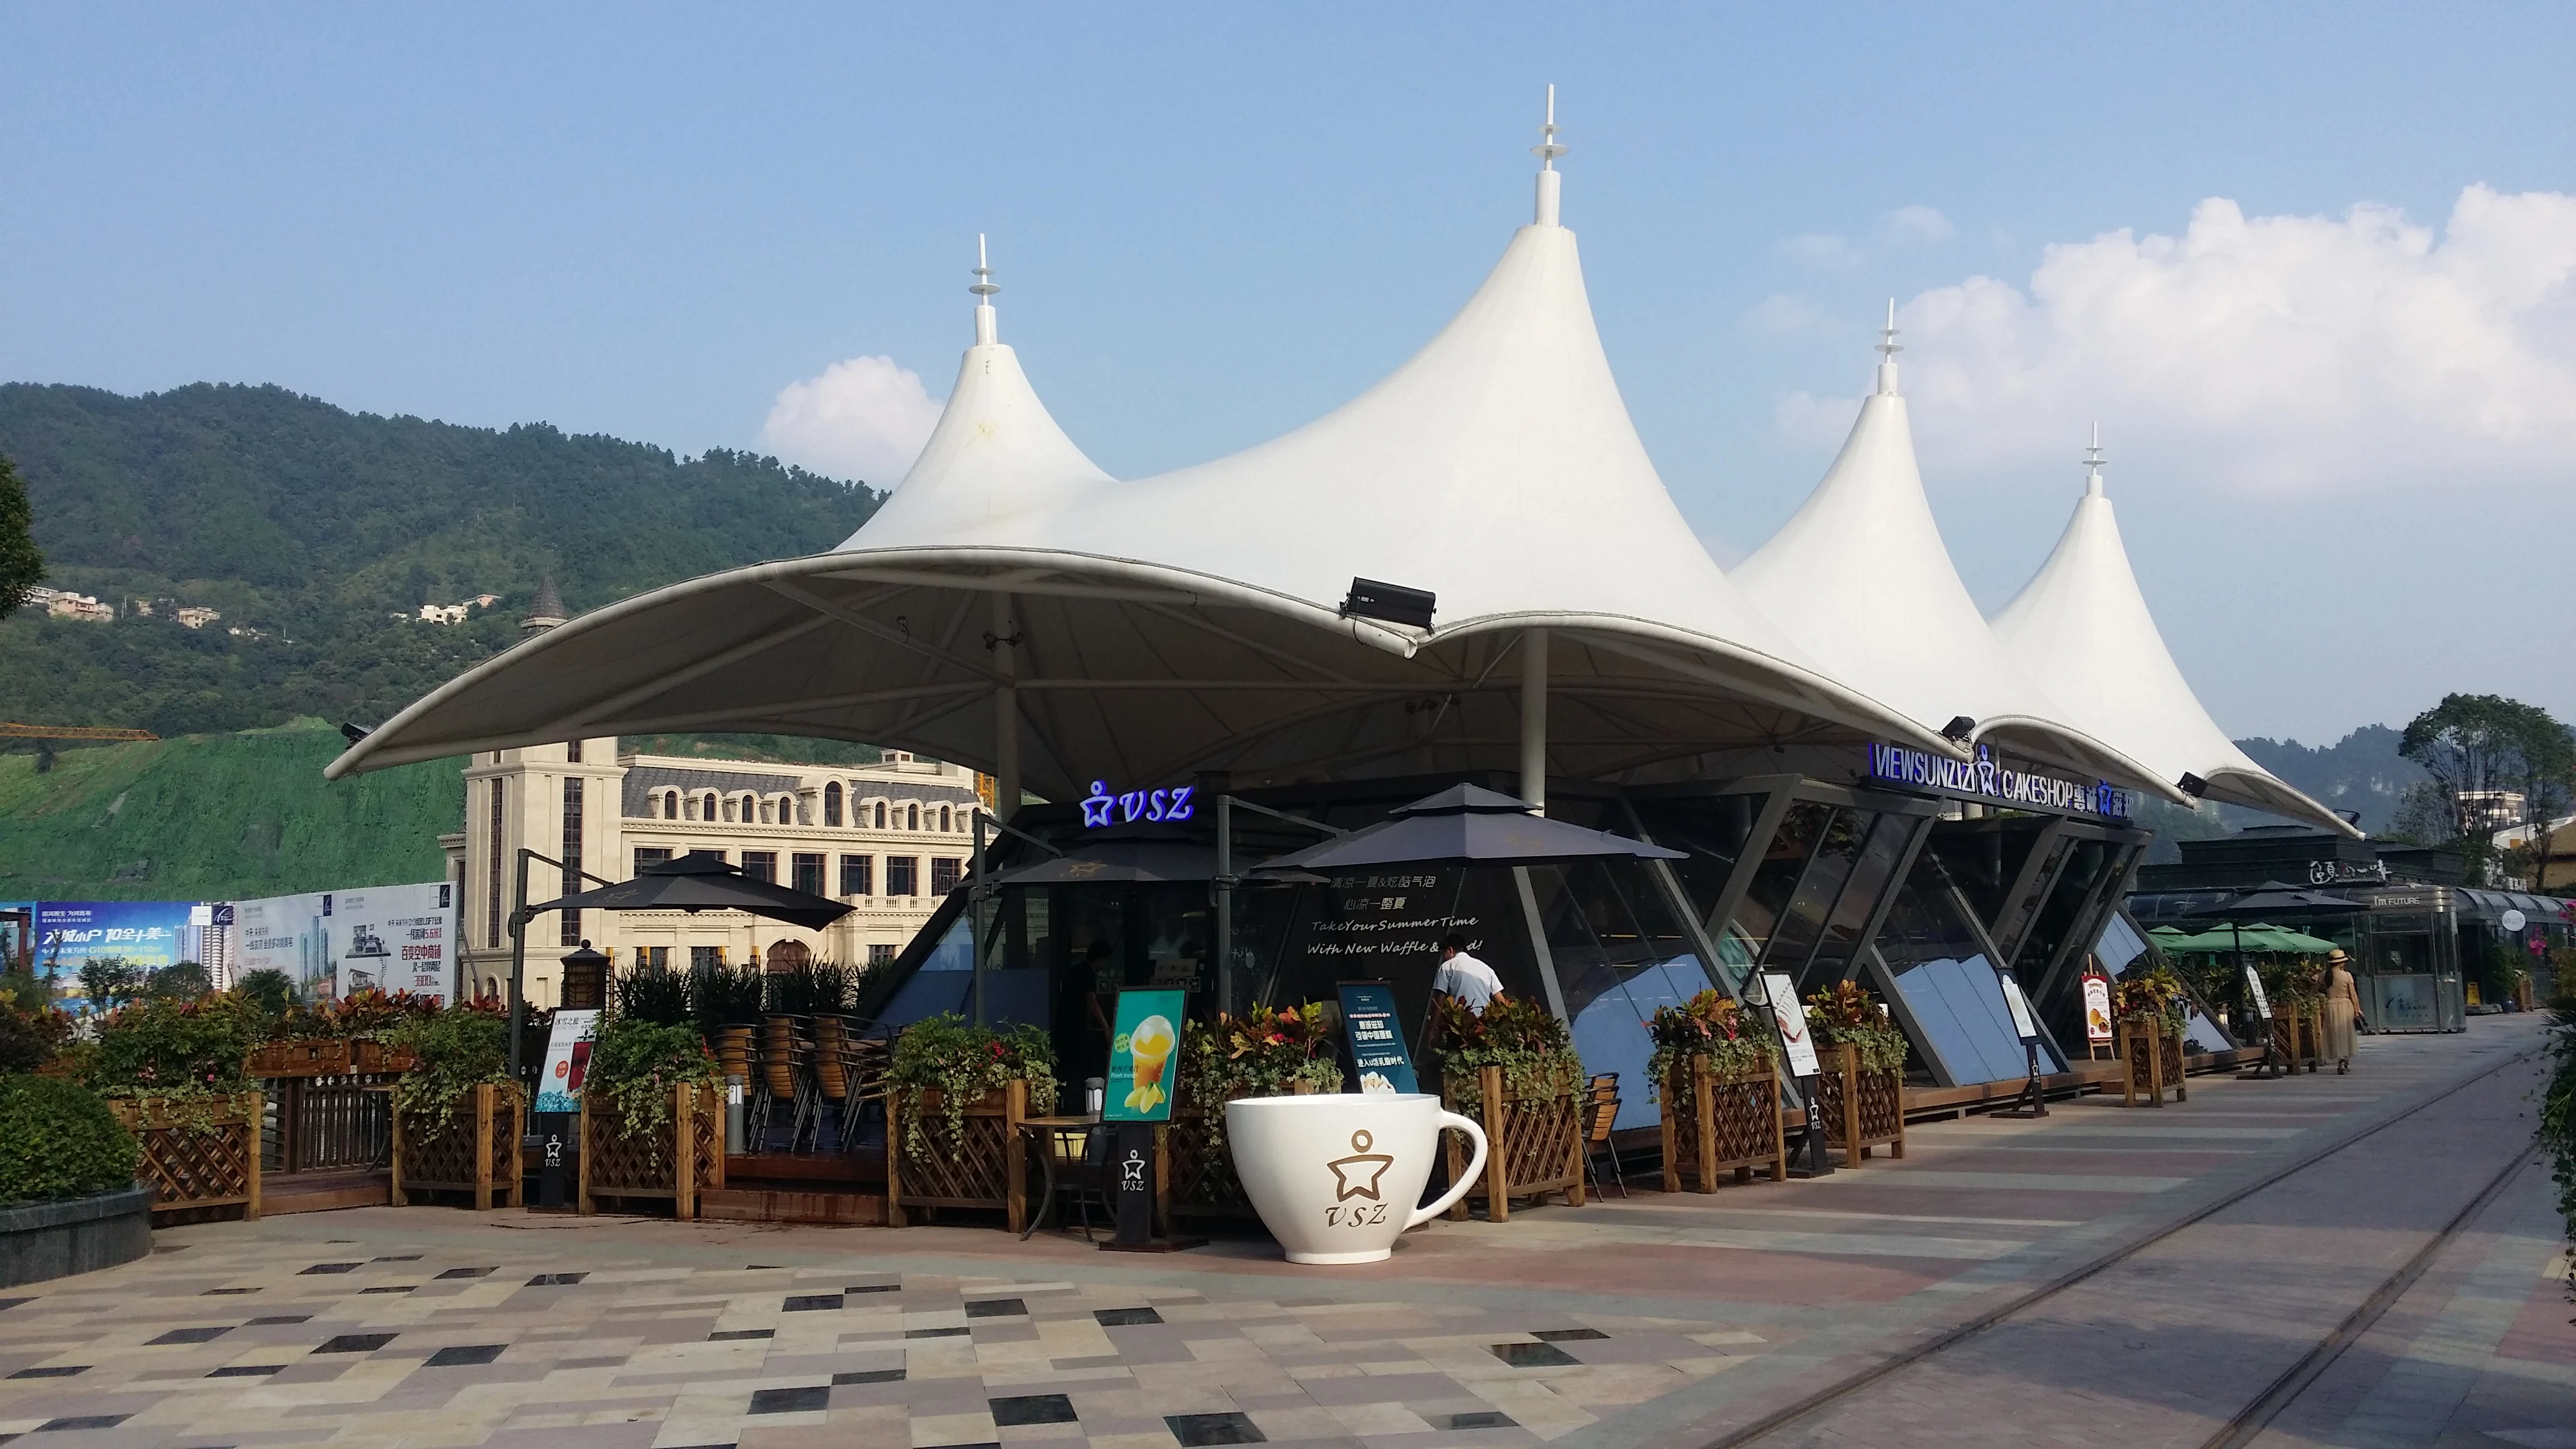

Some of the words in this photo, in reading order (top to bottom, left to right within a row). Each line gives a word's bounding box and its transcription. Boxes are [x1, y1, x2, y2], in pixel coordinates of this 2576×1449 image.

[2002, 769, 2073, 809] CAKESHOP
[1118, 786, 1194, 823] VSZ
[1330, 875, 1437, 889] 清凉一夏&炫酷气泡
[1344, 896, 1407, 910] 心凉一整夏
[2374, 895, 2387, 906] I'm
[2388, 897, 2420, 905] FUTURE
[1307, 943, 1342, 955] With
[1344, 942, 1377, 955] New
[1380, 940, 1429, 956] Waffle
[1430, 941, 1439, 953] &
[1354, 1030, 1393, 1041] 引领中国蛋糕
[545, 1158, 562, 1168] VSZ
[1121, 1180, 1144, 1192] VSZ
[1325, 1203, 1390, 1228] VSZ
